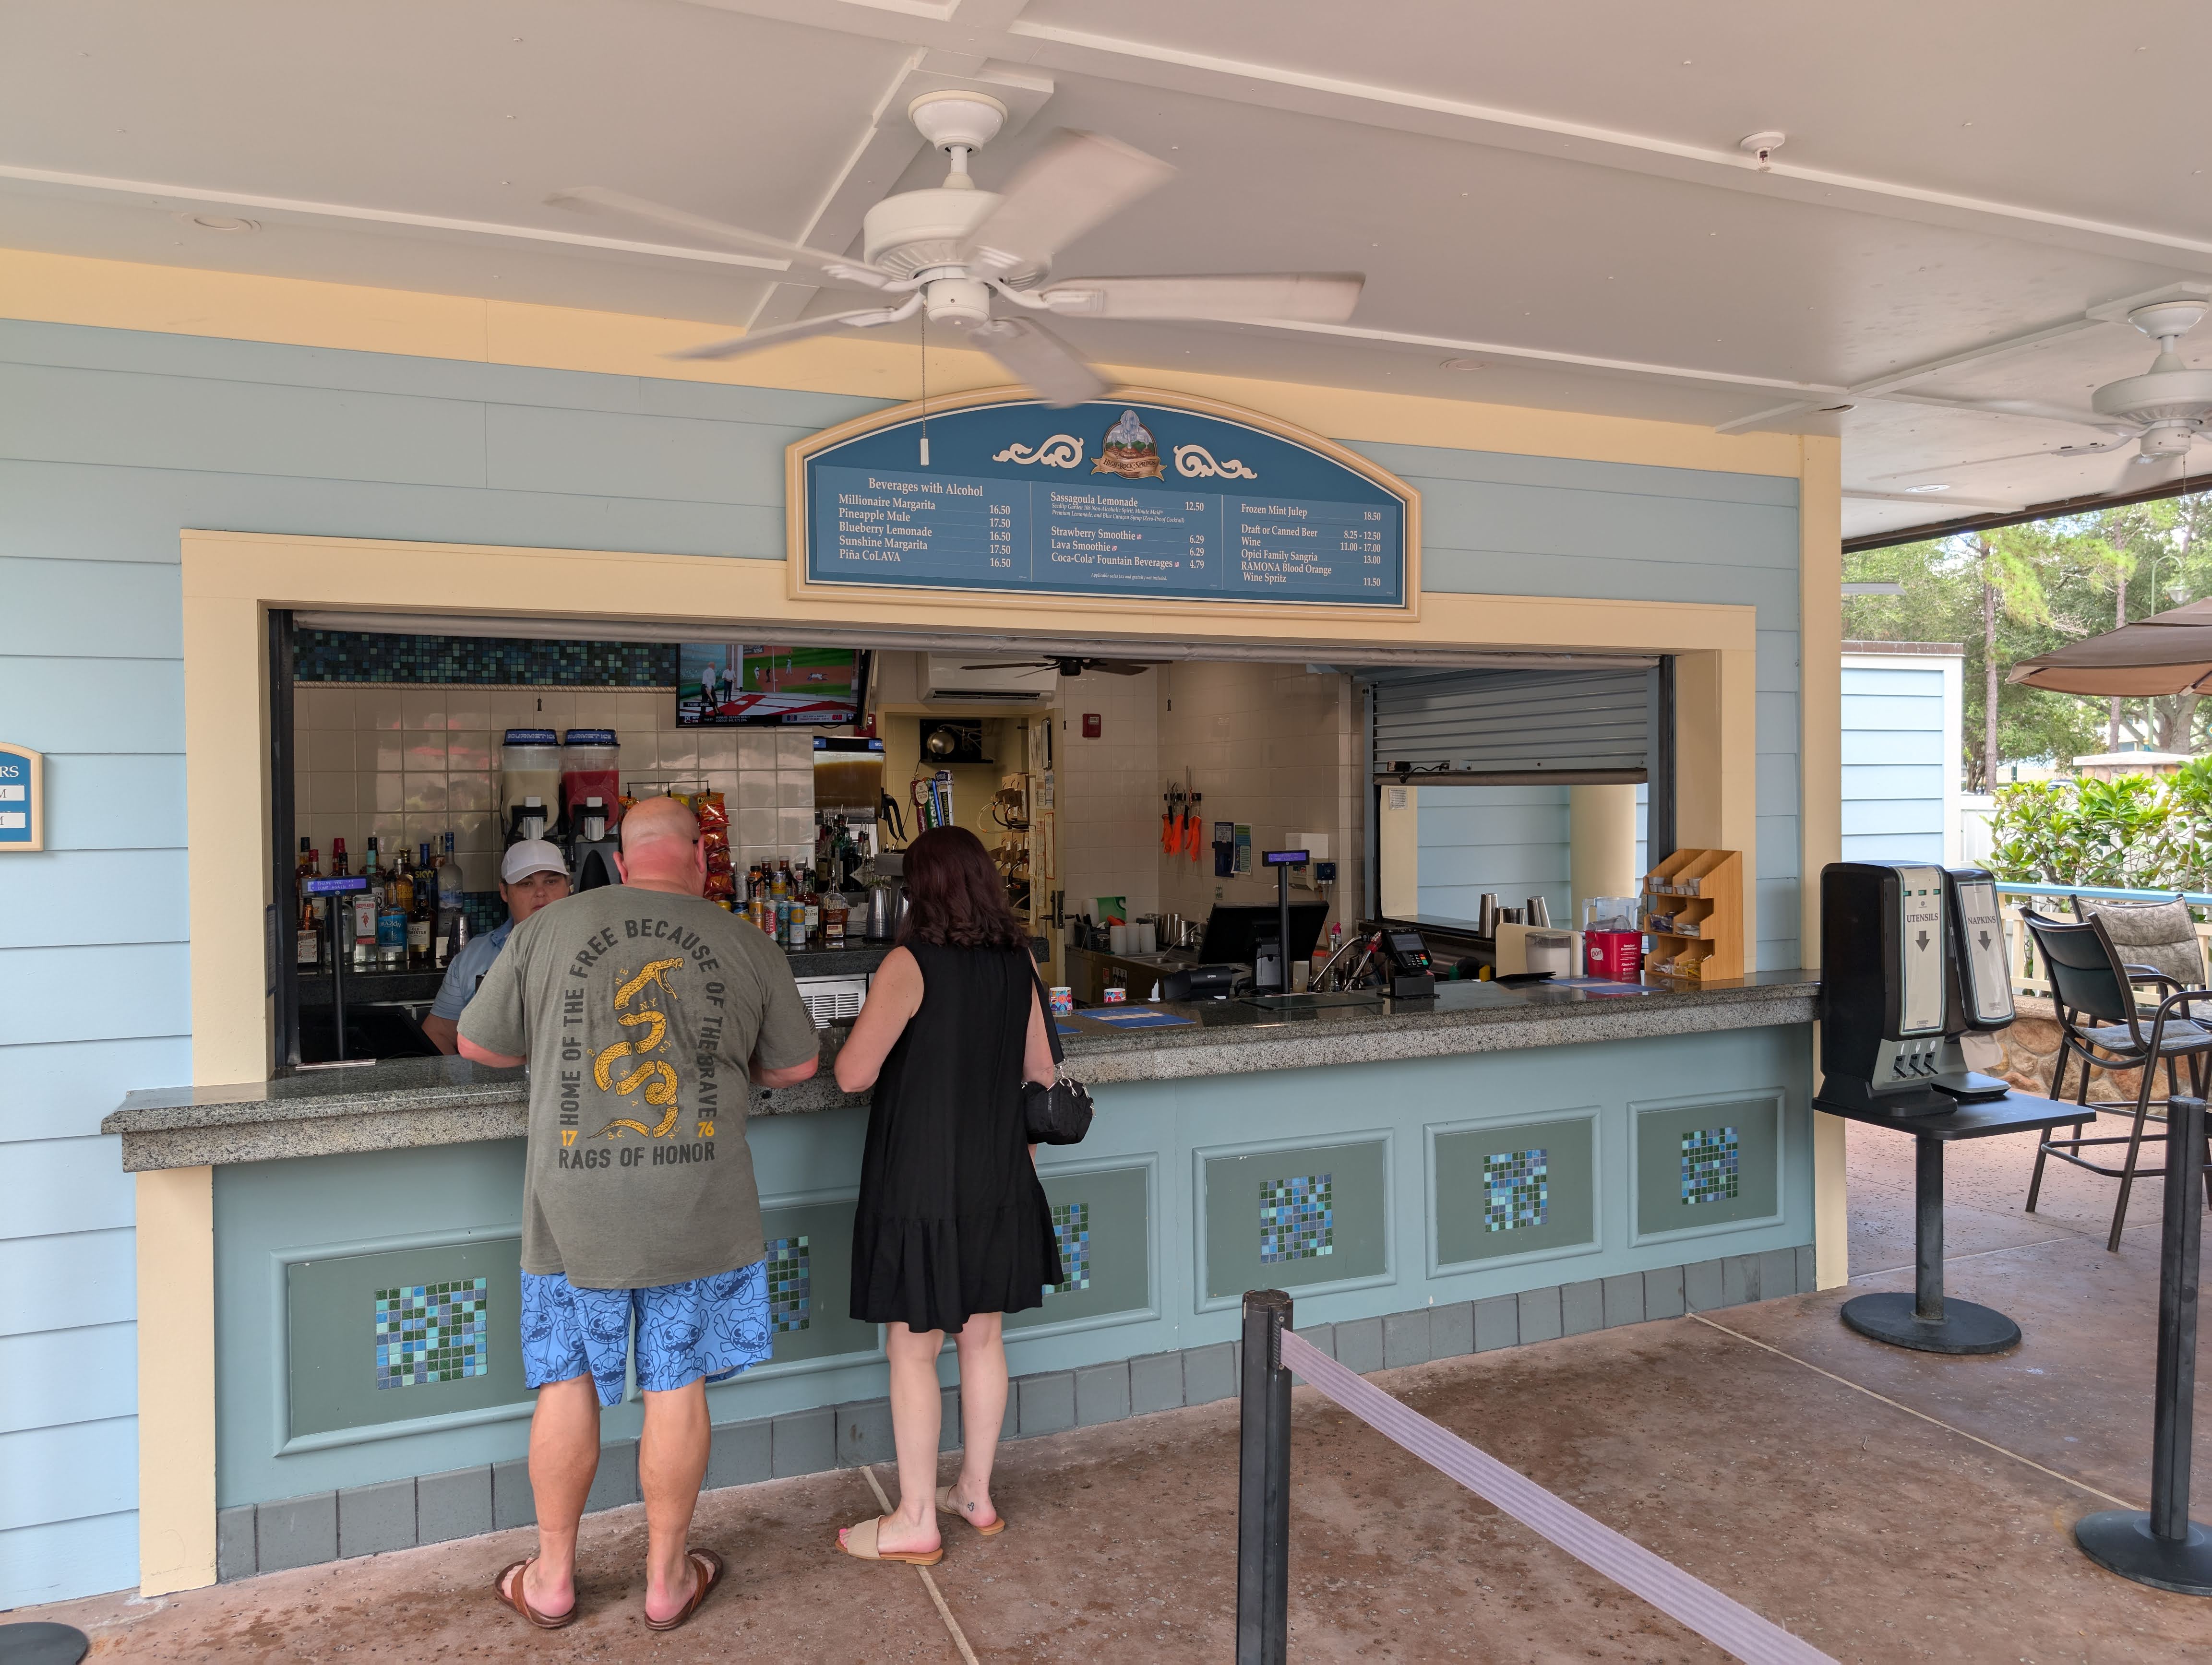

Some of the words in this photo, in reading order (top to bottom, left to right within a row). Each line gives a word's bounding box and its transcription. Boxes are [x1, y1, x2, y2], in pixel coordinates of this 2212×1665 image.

[1103, 458, 1118, 467] HIGH
[1135, 460, 1156, 468] SPRINGS
[869, 477, 918, 494] Beverages
[921, 482, 943, 493] with
[945, 484, 983, 496] Alcohol
[838, 494, 890, 507] Millionaire
[893, 498, 935, 511] Margarita
[990, 505, 1010, 515] 16.50
[1051, 492, 1095, 506] Sassagoula
[1098, 495, 1138, 507] Lemonade
[1185, 501, 1204, 511] 12.50
[839, 508, 884, 522] Pineapple
[887, 511, 910, 522] Mule
[990, 518, 1010, 528] 17.50
[1241, 504, 1267, 514] Frozen
[1268, 506, 1286, 515] Mint
[1288, 507, 1307, 519] Julep
[1363, 511, 1381, 521] 18.50
[839, 522, 884, 536] Blueberry
[886, 524, 933, 536] Lemonade
[990, 531, 1010, 541] 16.50
[1051, 526, 1096, 540] Strawberry
[1098, 529, 1136, 540] Smoothie
[1189, 535, 1204, 544] 6.29
[1241, 524, 1260, 534] Draft
[1272, 526, 1300, 536] Canned
[1302, 528, 1318, 537] Beer
[1344, 531, 1357, 539] 8.25
[1363, 532, 1381, 541] 12.50
[839, 535, 882, 547] Sunshine
[885, 538, 928, 552] Margarita
[990, 545, 1010, 555] 17.50
[1052, 539, 1070, 549] Lava
[1073, 541, 1111, 552] Smoothie
[1189, 547, 1204, 557] 6.29
[1241, 536, 1261, 547] Wine
[1340, 542, 1357, 551] 11.00
[1363, 543, 1380, 552] 17.00
[839, 549, 860, 560] Piña
[862, 551, 901, 562] CoLAVA
[990, 558, 1011, 568] 16.50
[1097, 555, 1132, 566] Fountain
[1134, 557, 1172, 570] Beverages
[1189, 559, 1204, 569] 4.79
[1241, 549, 1262, 561] Opici
[1264, 550, 1289, 562] Family
[1291, 552, 1317, 563] Sangria
[1363, 555, 1380, 564] 13.00
[1241, 561, 1280, 572] RAMONA
[1282, 564, 1303, 573] Blood
[1305, 565, 1332, 576] Orange
[1243, 572, 1262, 582] Wine
[1264, 573, 1287, 584] Spritz
[1363, 578, 1380, 586] 11.50
[415, 870, 435, 879] SKYY
[1906, 913, 1938, 923] UTENSILS
[1968, 916, 1996, 925] NAPKINS
[570, 927, 619, 979] FREE
[625, 918, 719, 972] BECAUSE
[705, 982, 725, 1009] OF
[563, 988, 584, 1028] THE
[698, 1016, 723, 1050] THE
[562, 1037, 582, 1060] OF
[696, 1056, 717, 1118] BRAVE
[560, 1070, 581, 1125] HOME
[561, 1130, 578, 1146] 17
[698, 1121, 715, 1138] 76
[559, 1149, 611, 1169] RAGS
[620, 1147, 645, 1167] OF
[653, 1142, 715, 1166] HONOR
